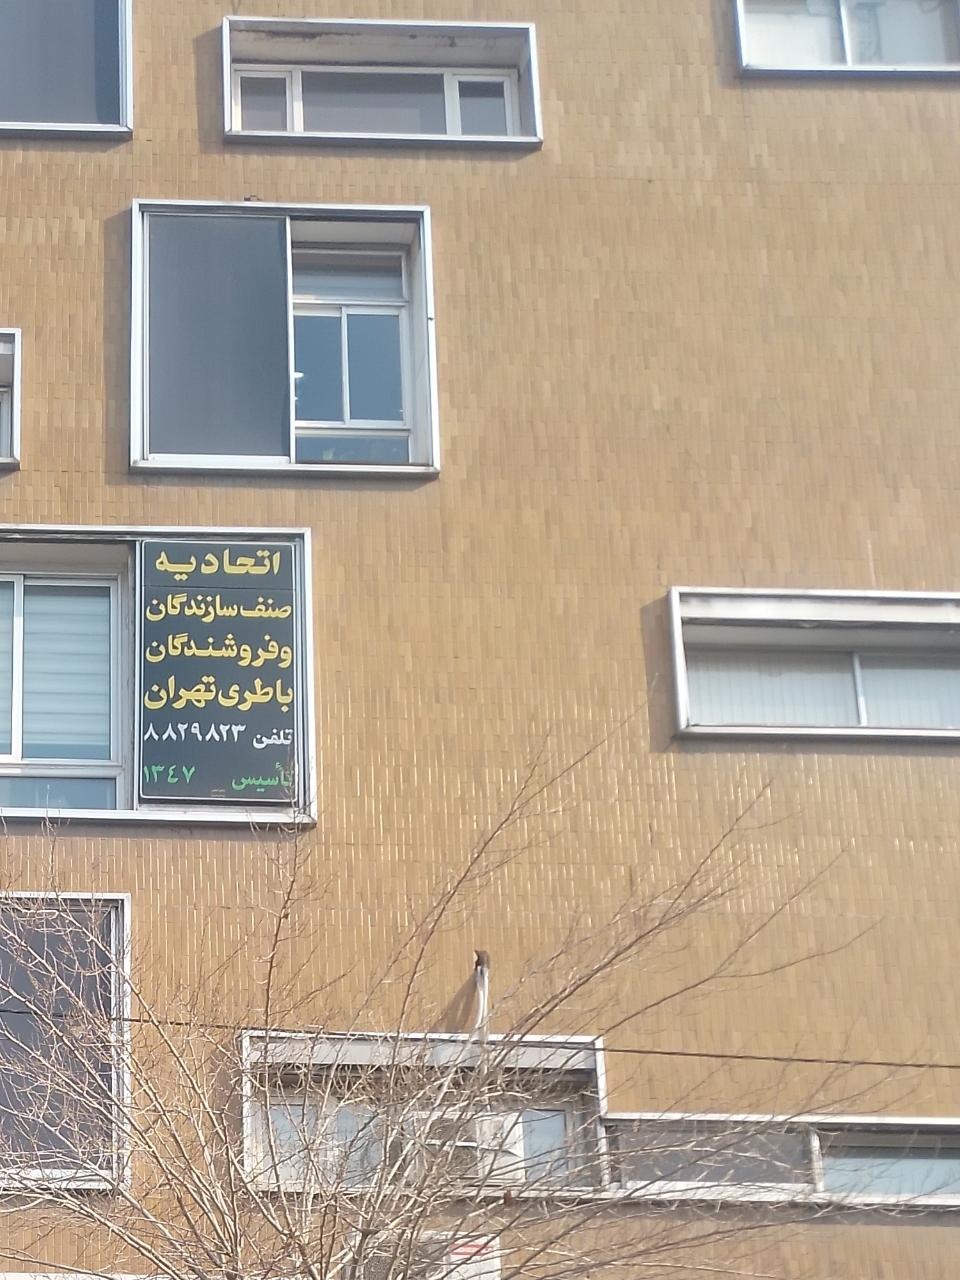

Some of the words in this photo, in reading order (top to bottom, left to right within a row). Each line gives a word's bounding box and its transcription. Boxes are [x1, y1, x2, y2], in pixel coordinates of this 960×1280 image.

[155, 548, 281, 581] اتحادیه
[146, 593, 238, 623] سازندگان
[240, 596, 292, 619] صنف
[143, 675, 217, 709] تهران
[218, 678, 294, 712] باطری
[252, 728, 294, 749] تلفن
